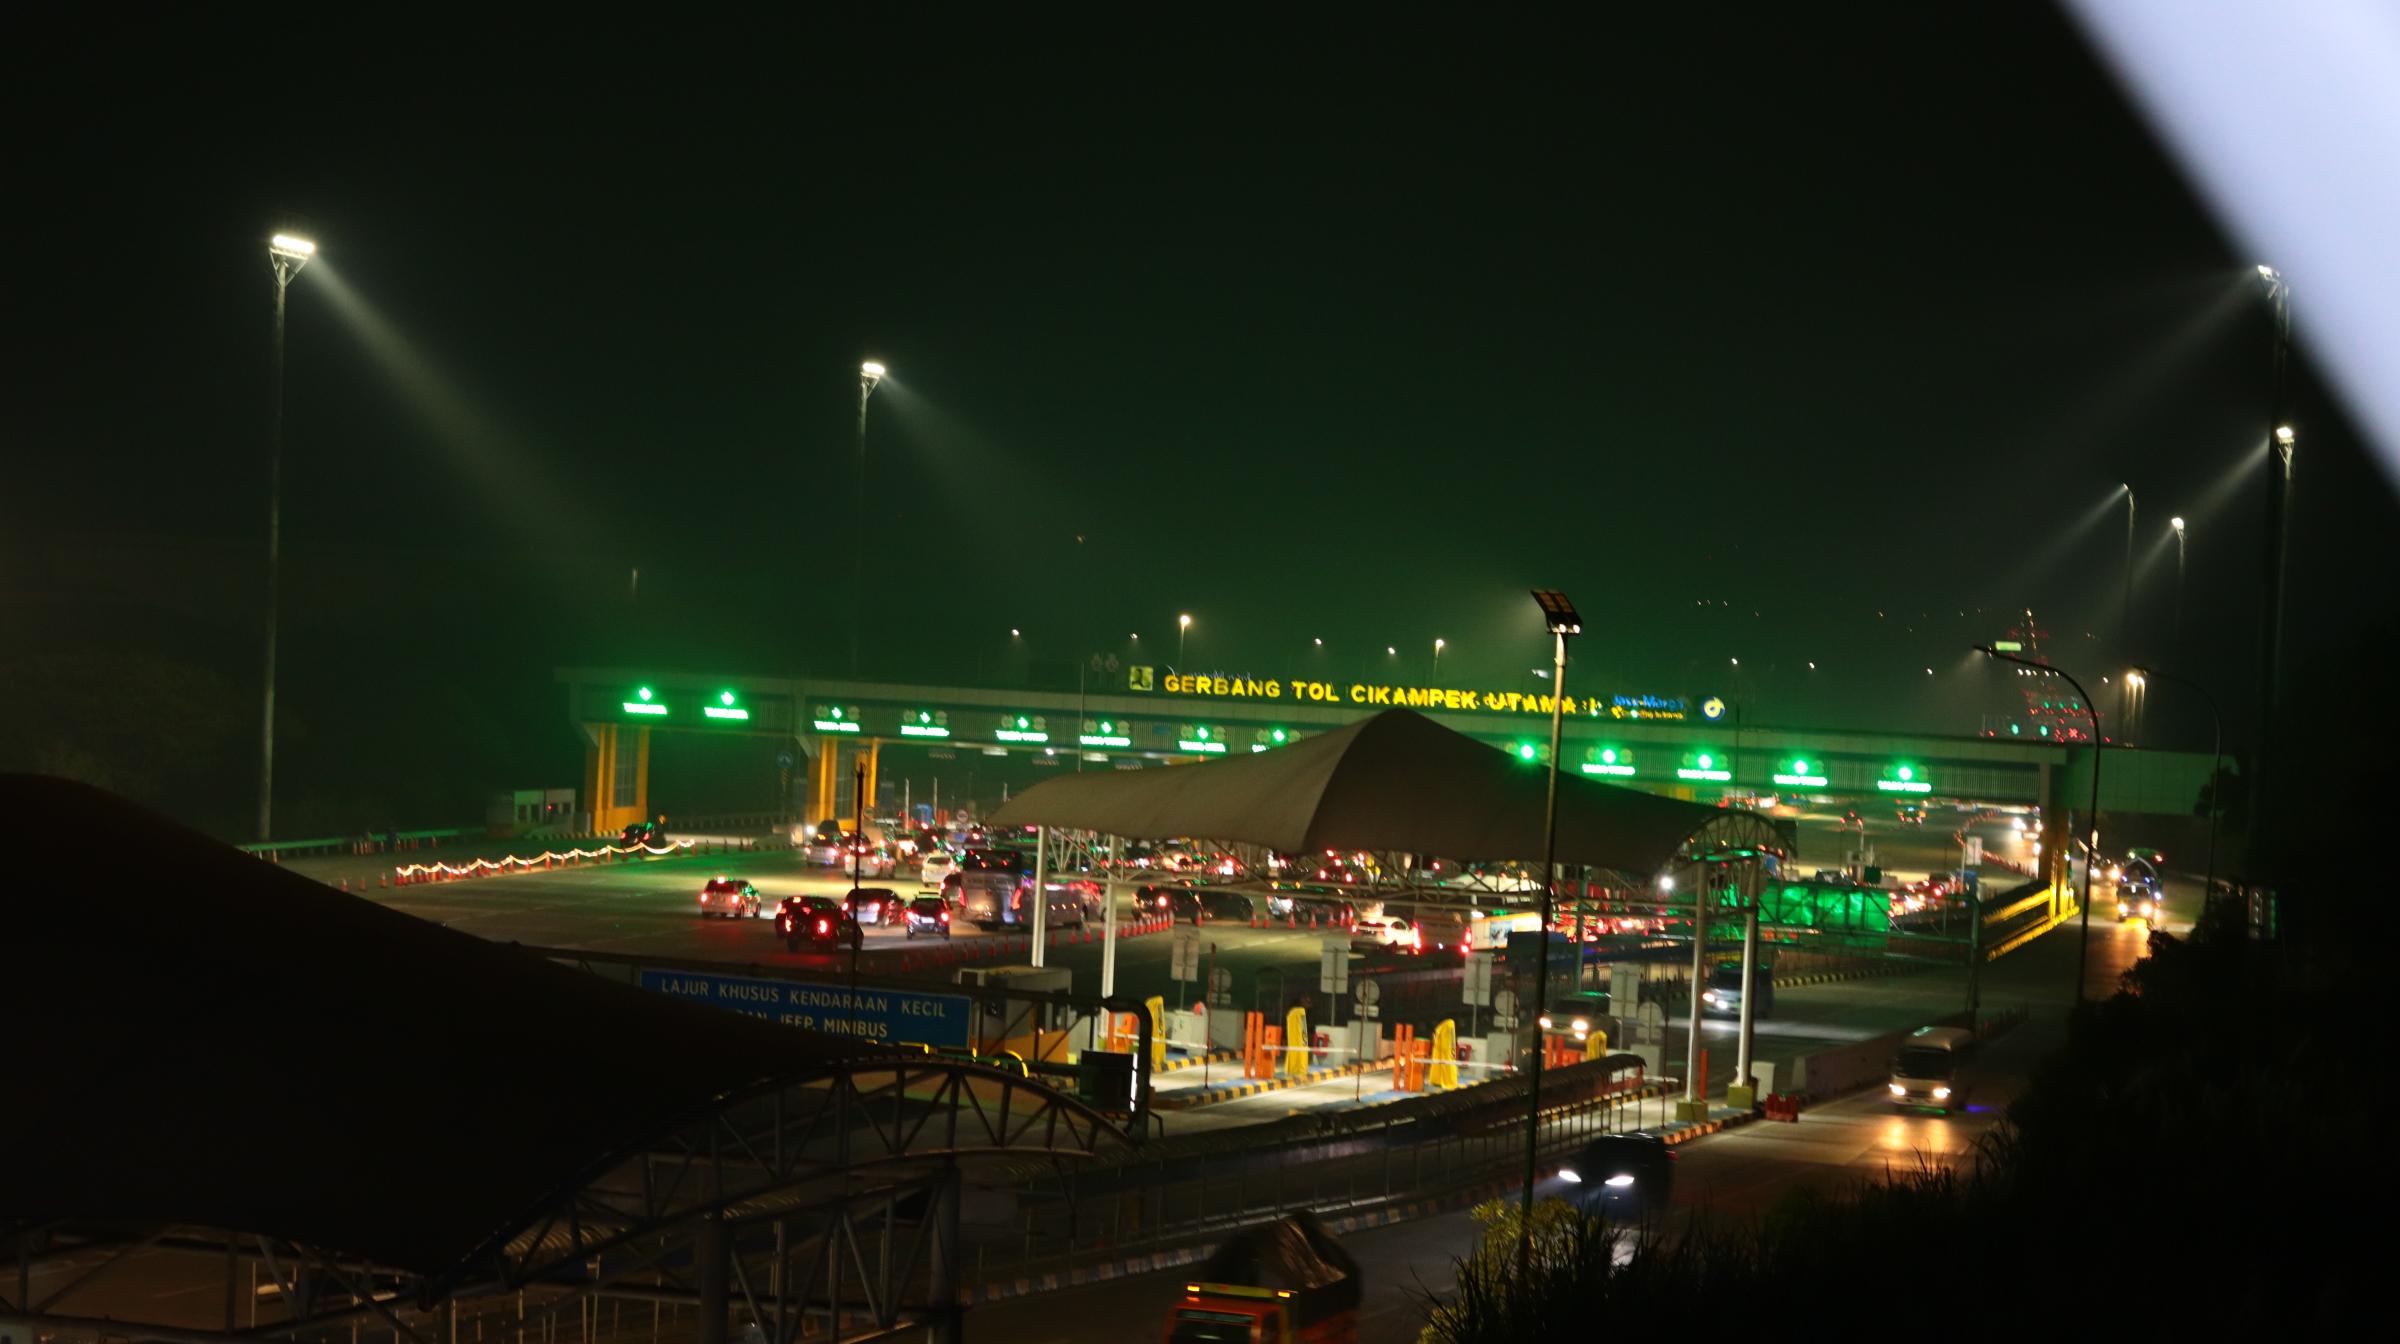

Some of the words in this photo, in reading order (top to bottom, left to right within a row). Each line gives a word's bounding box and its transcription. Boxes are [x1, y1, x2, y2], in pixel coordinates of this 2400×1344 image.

[1164, 674, 1281, 698] GERBANG
[1291, 680, 1340, 702] TOL
[1350, 684, 1477, 710] CIKAMPEK
[1487, 692, 1576, 714] UTAMA
[661, 978, 710, 998] LAJUR
[719, 983, 780, 1003] KHUSUS
[789, 989, 888, 1013] KENDARAAN
[901, 1000, 947, 1018] KECIL
[823, 1019, 888, 1038] MINIBUS
